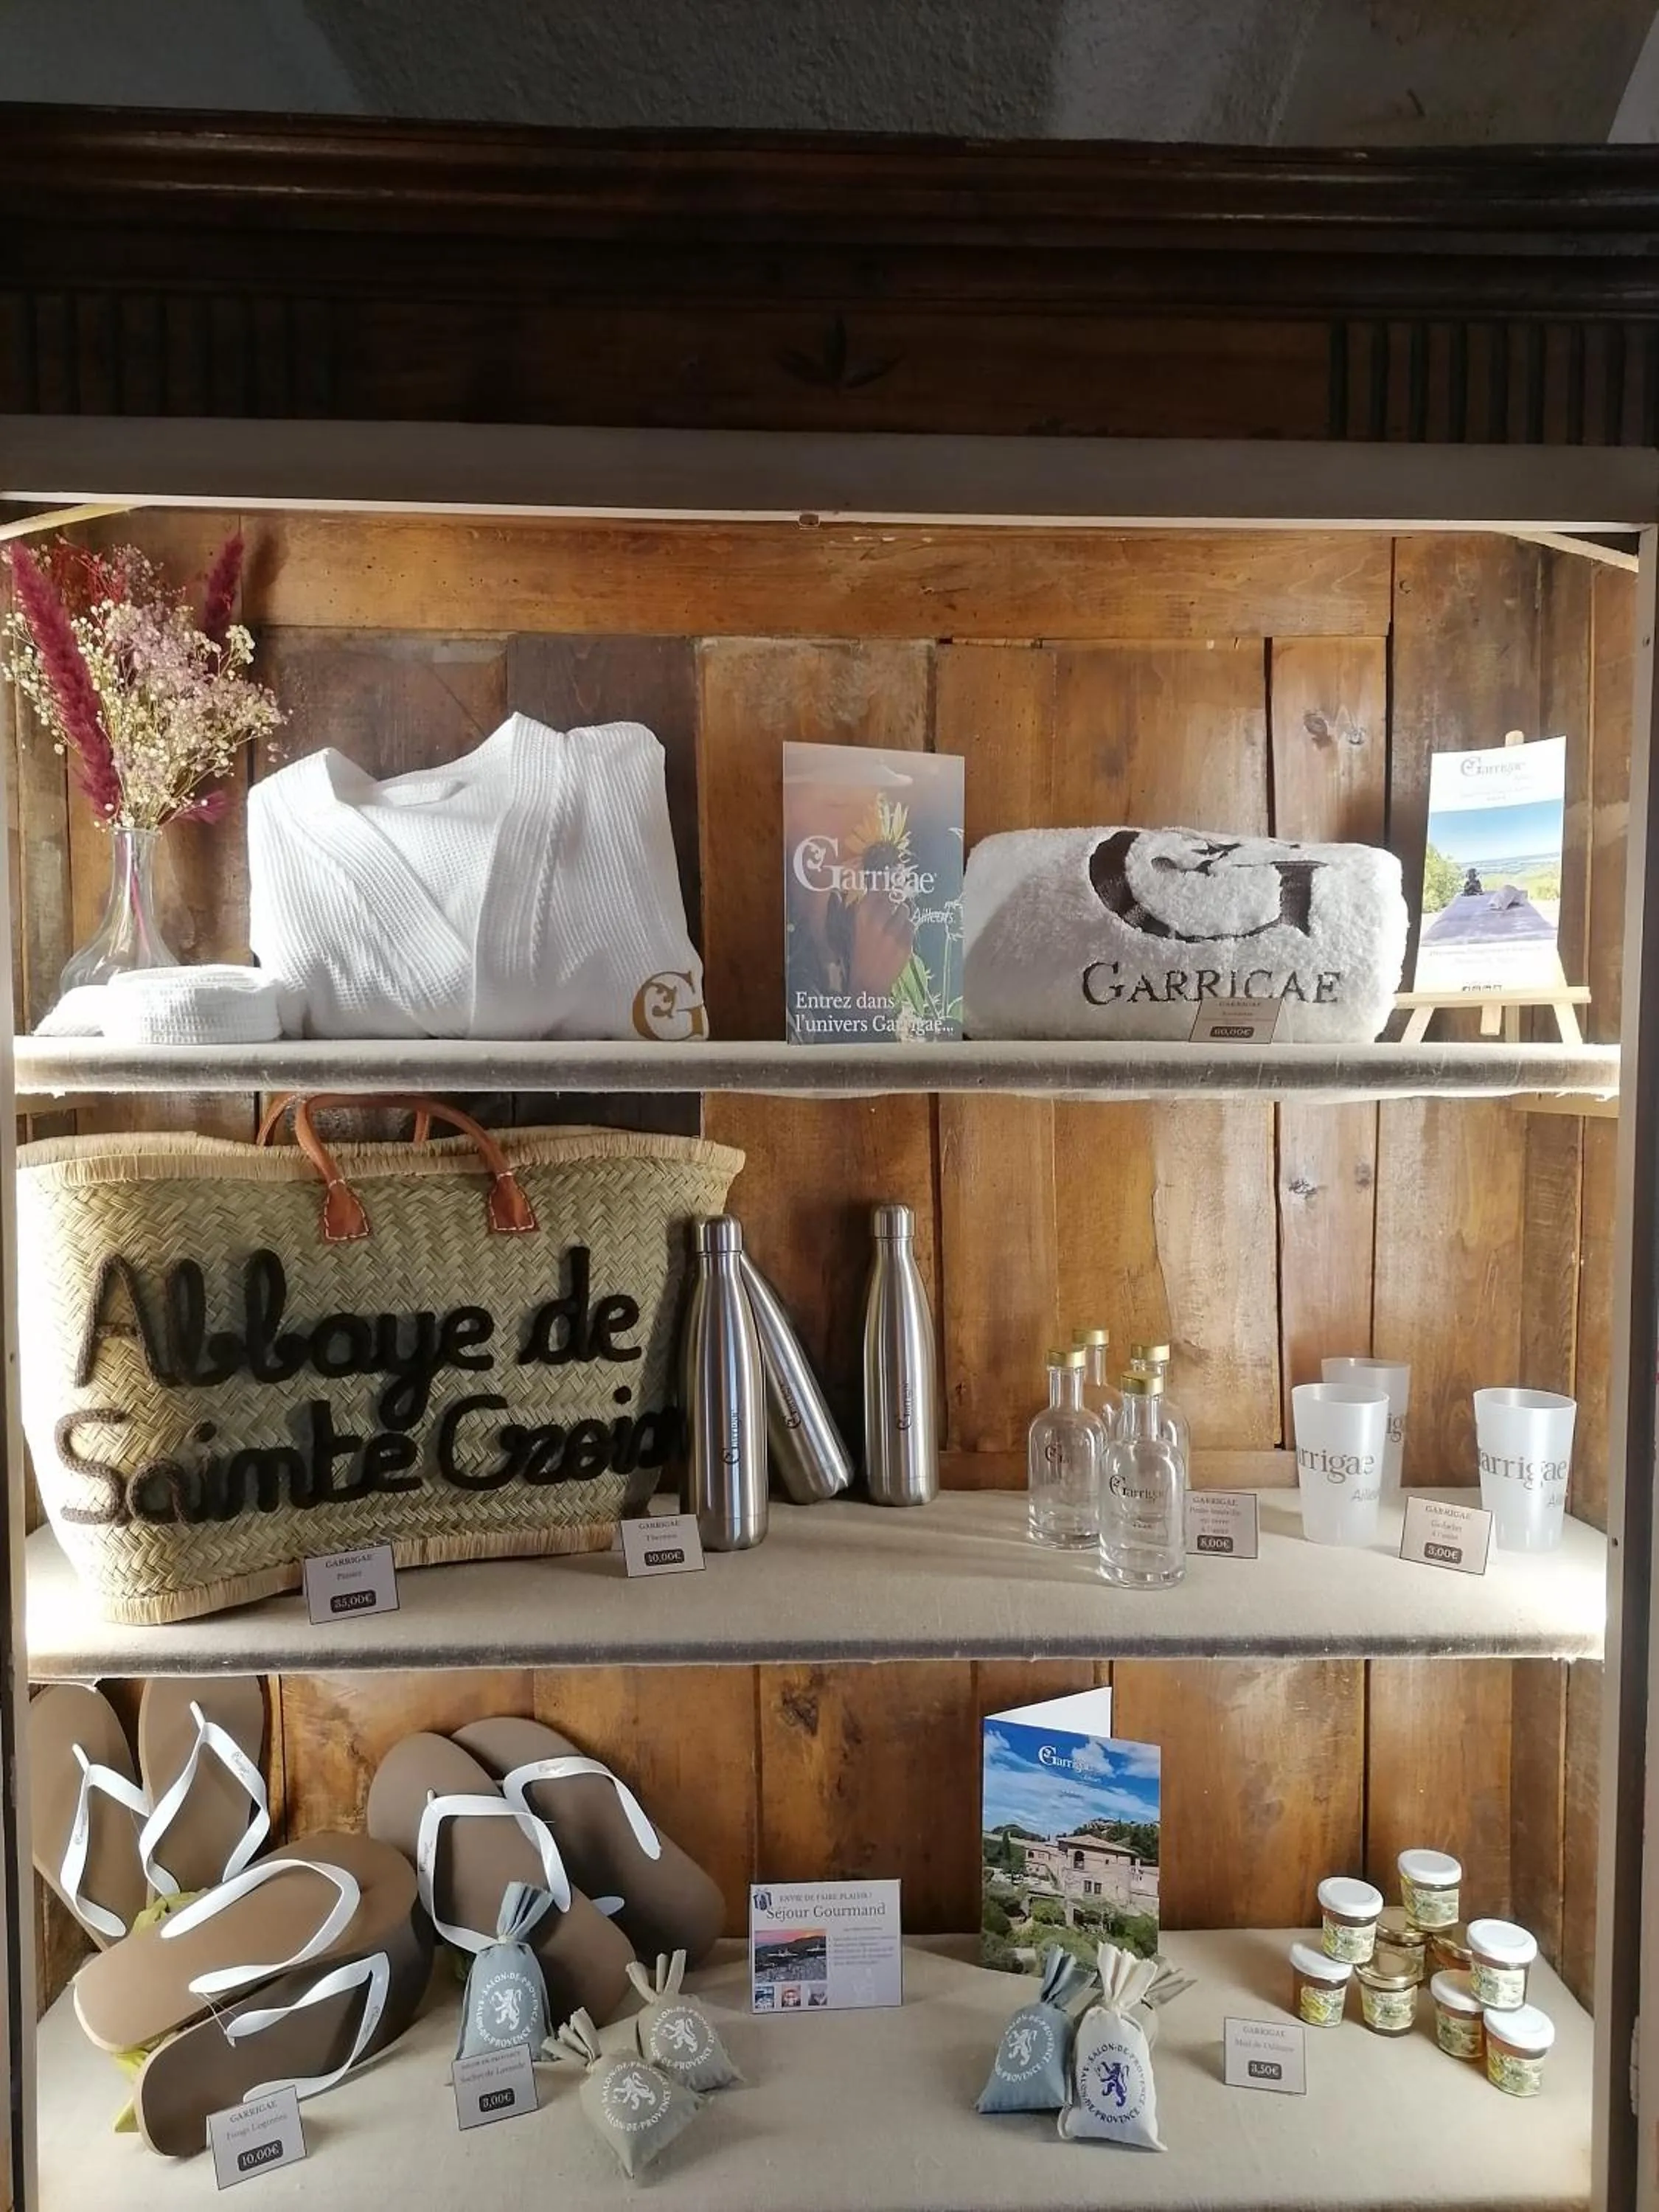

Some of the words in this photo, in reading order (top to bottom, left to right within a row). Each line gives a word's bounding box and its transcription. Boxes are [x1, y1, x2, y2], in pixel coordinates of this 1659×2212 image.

[793, 835, 936, 904] Garrigae
[795, 990, 852, 1009] Entrez
[856, 990, 894, 1009] dans
[795, 1014, 868, 1032] l'univers
[75, 1248, 495, 1431] Abbaye
[518, 1245, 642, 1367] de
[55, 1398, 424, 1526] Sainte
[766, 1905, 810, 1922] Séjour
[813, 1902, 886, 1918] Gourmand
[229, 2101, 278, 2124] GARRIGAE
[240, 2142, 280, 2166] 10,00€
